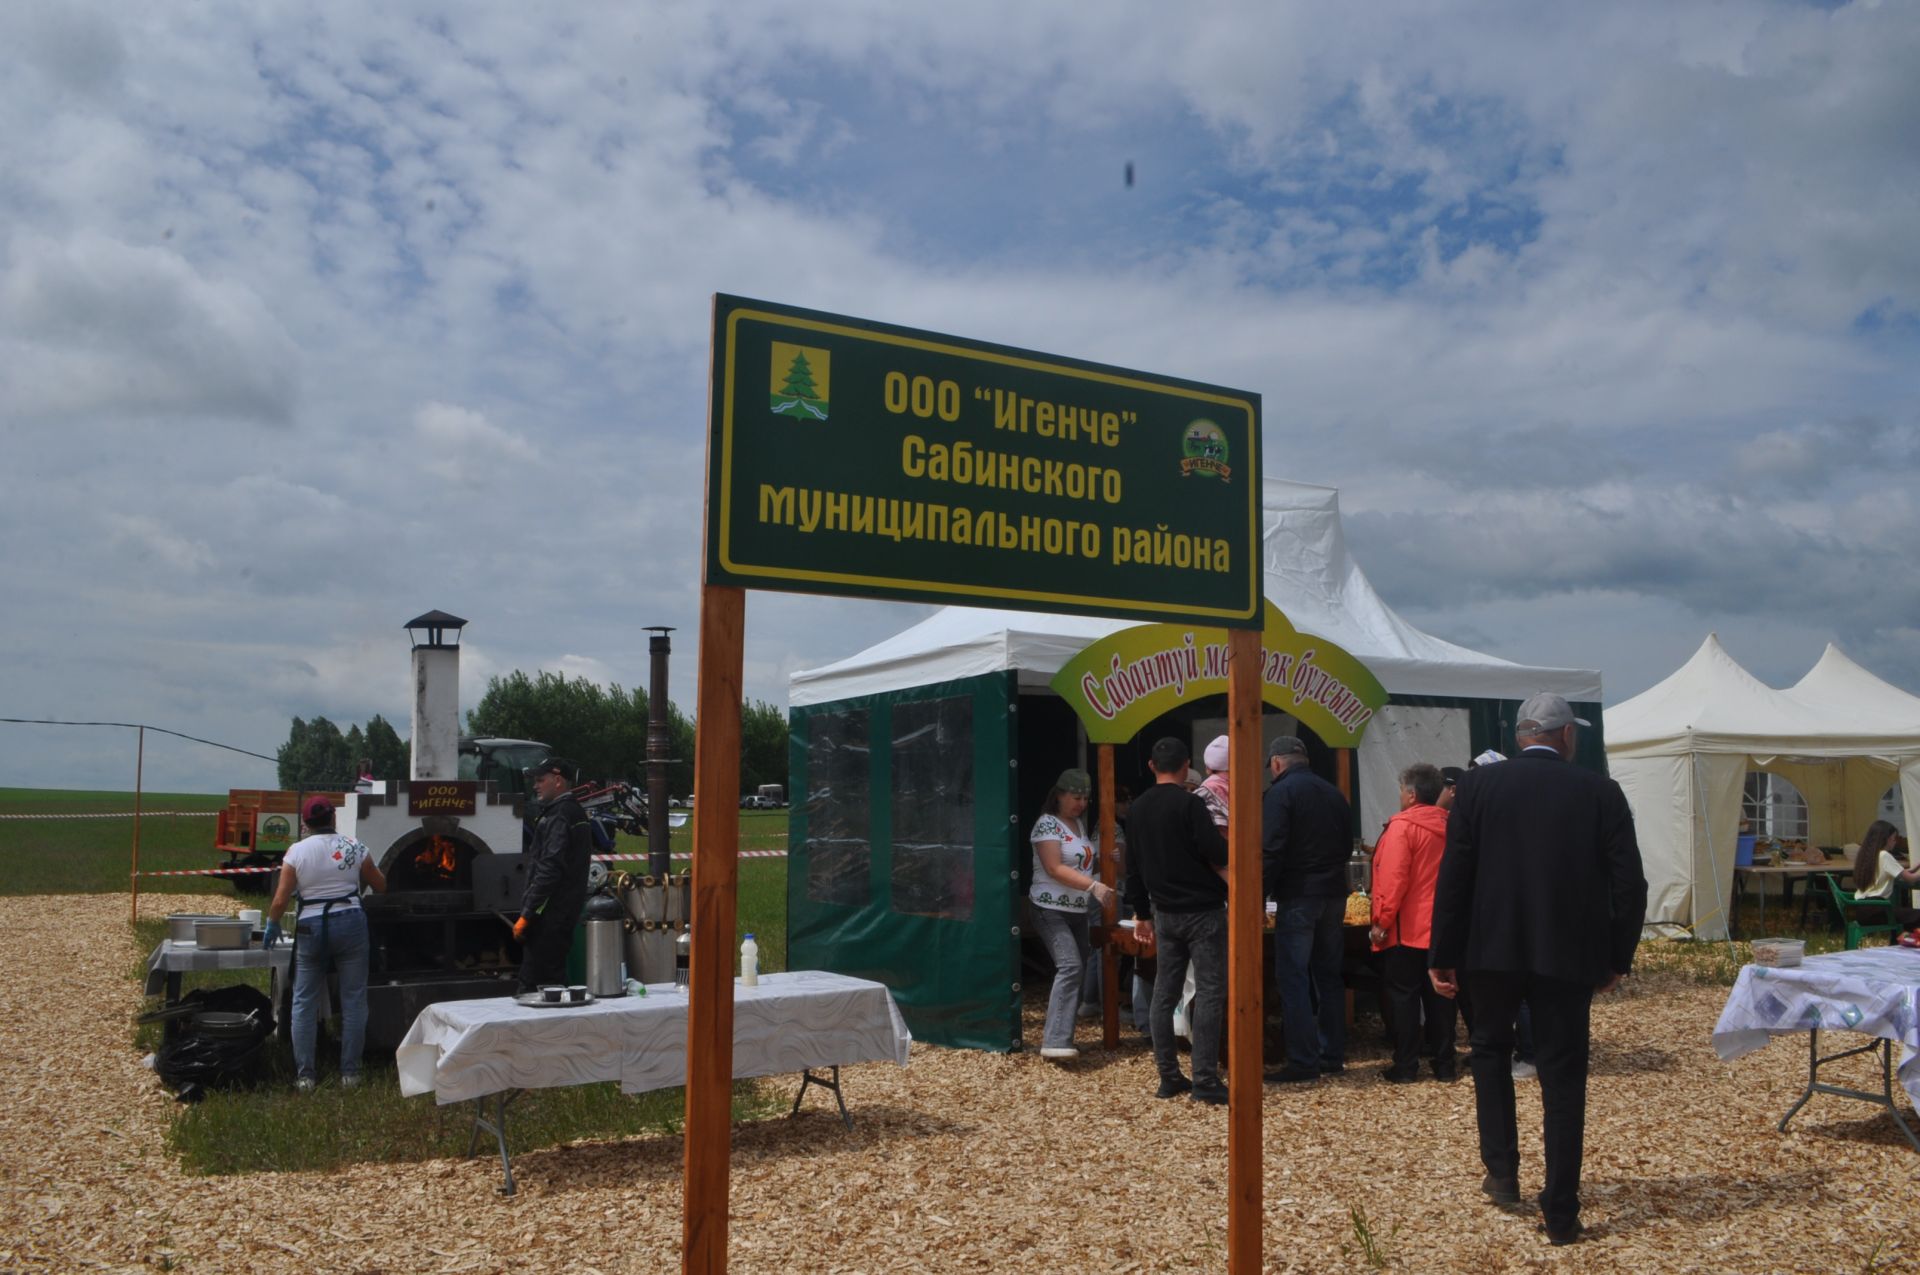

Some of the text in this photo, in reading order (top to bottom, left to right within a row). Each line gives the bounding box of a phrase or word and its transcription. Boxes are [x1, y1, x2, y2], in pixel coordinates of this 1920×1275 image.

[885, 371, 960, 422] ООО
[902, 434, 1121, 504] Сабинского
[759, 483, 1230, 573] муниципального района
[1082, 633, 1199, 719] Сабантуй
[1291, 649, 1372, 733] булсын!
[428, 785, 458, 796] ООО
